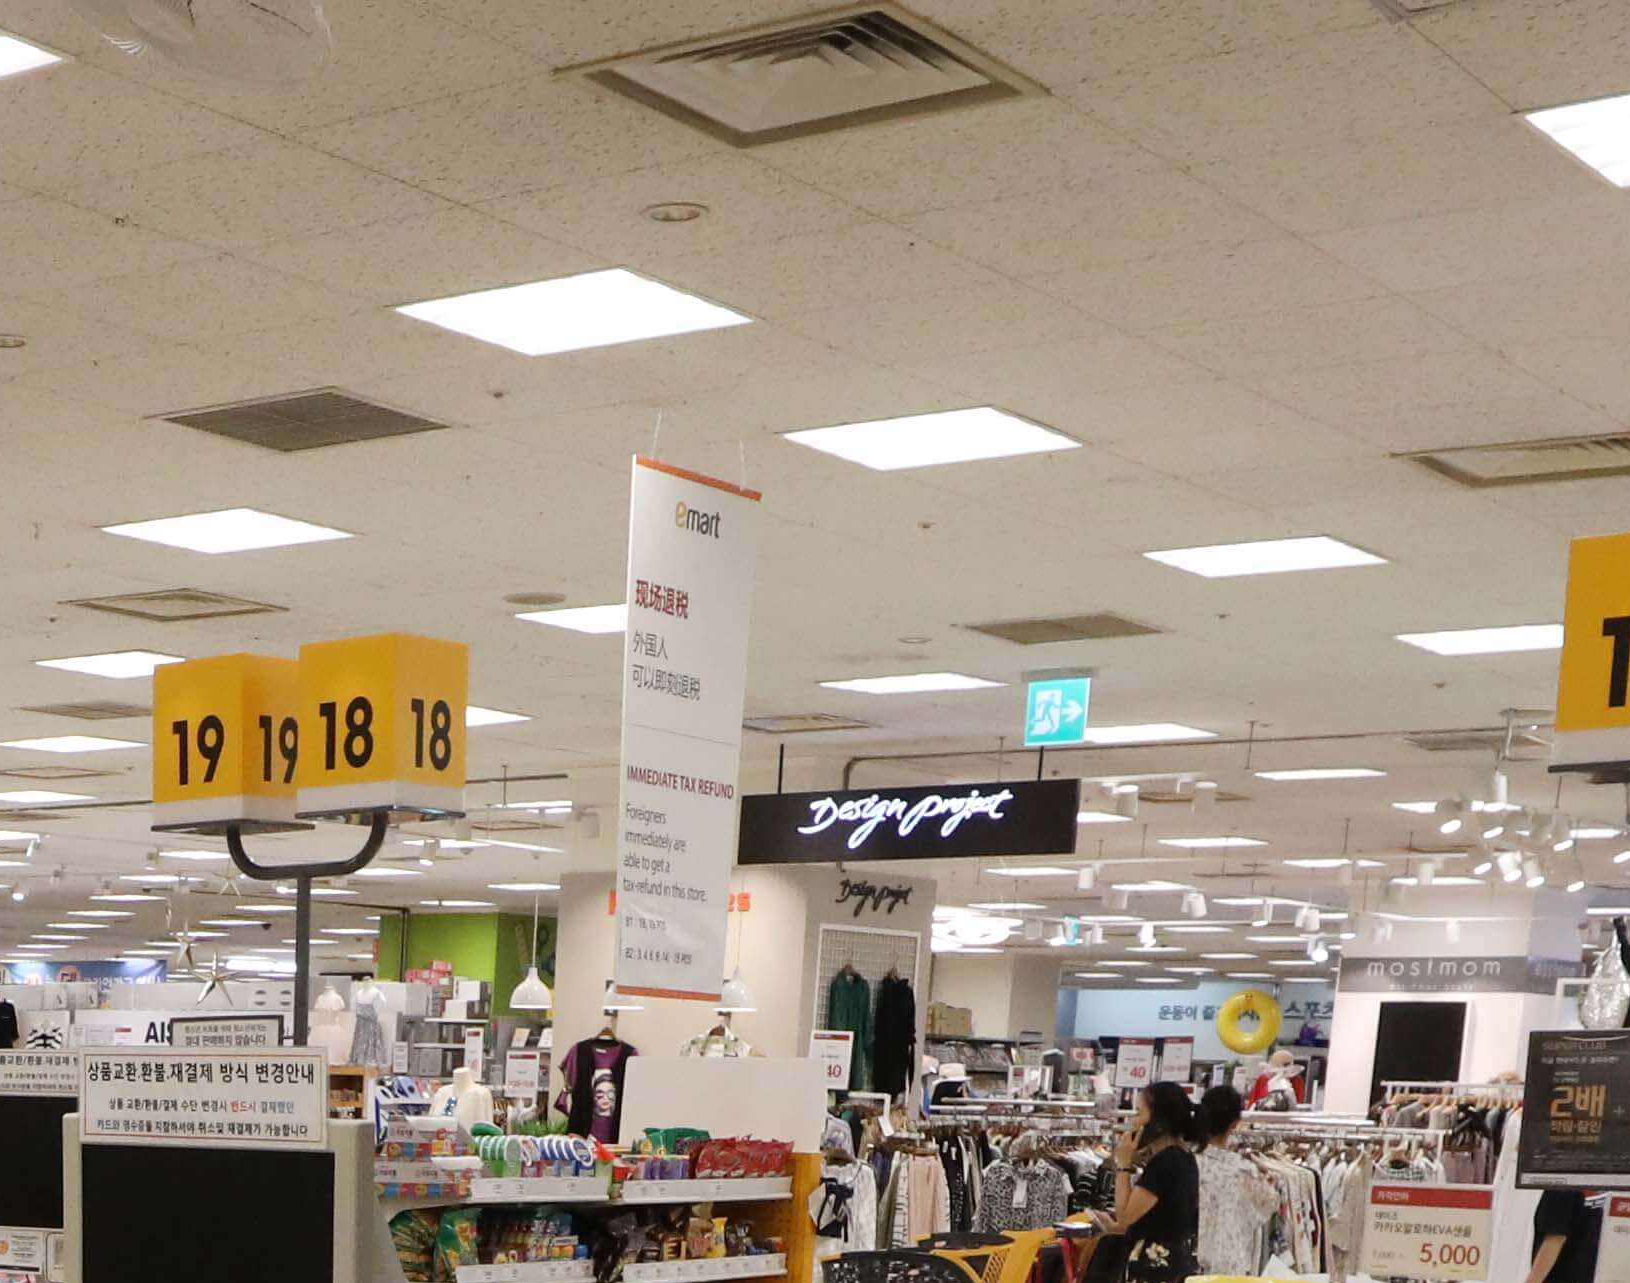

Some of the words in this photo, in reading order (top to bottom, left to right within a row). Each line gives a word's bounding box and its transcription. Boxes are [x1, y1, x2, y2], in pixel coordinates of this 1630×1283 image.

[676, 501, 721, 538] emart
[636, 579, 689, 619] 现场退税
[633, 630, 668, 660] 外国人
[172, 714, 225, 787] 19
[259, 714, 298, 786] 19
[319, 696, 374, 770] 18
[411, 698, 452, 771] 18
[627, 765, 678, 791] IMMEDIATE
[680, 776, 696, 793] TAX
[698, 779, 734, 800] REFUND
[626, 803, 667, 826] Foreigners
[798, 793, 904, 849] Design
[900, 789, 1014, 838] project
[625, 830, 672, 854] immediately
[673, 840, 686, 852] are
[623, 853, 641, 870] able
[642, 858, 650, 871] to
[651, 859, 665, 876] get
[672, 883, 686, 898] this
[220, 1063, 248, 1083] 방식
[255, 1062, 315, 1085] 변경안내
[1550, 1083, 1607, 1119] 2배
[1420, 1243, 1480, 1268] 5,000
